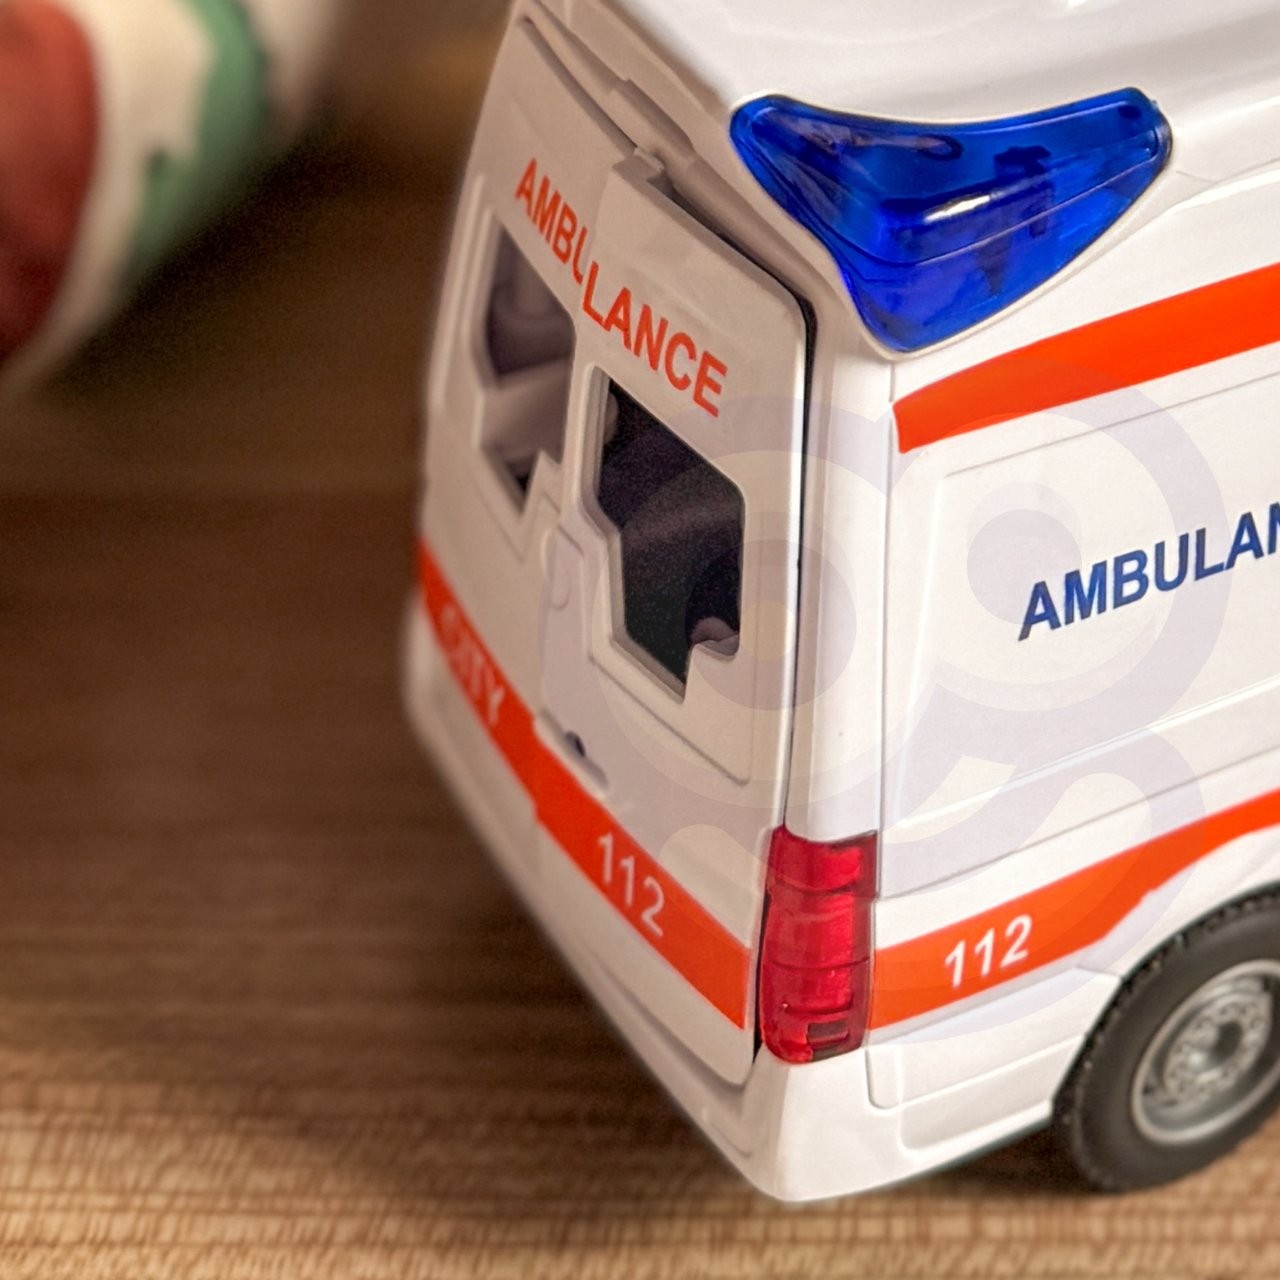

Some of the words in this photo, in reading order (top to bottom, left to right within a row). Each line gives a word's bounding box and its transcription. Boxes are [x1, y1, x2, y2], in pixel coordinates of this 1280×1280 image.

[515, 157, 729, 418] AMBULANCE
[597, 831, 665, 939] 112
[944, 913, 1033, 990] 112
